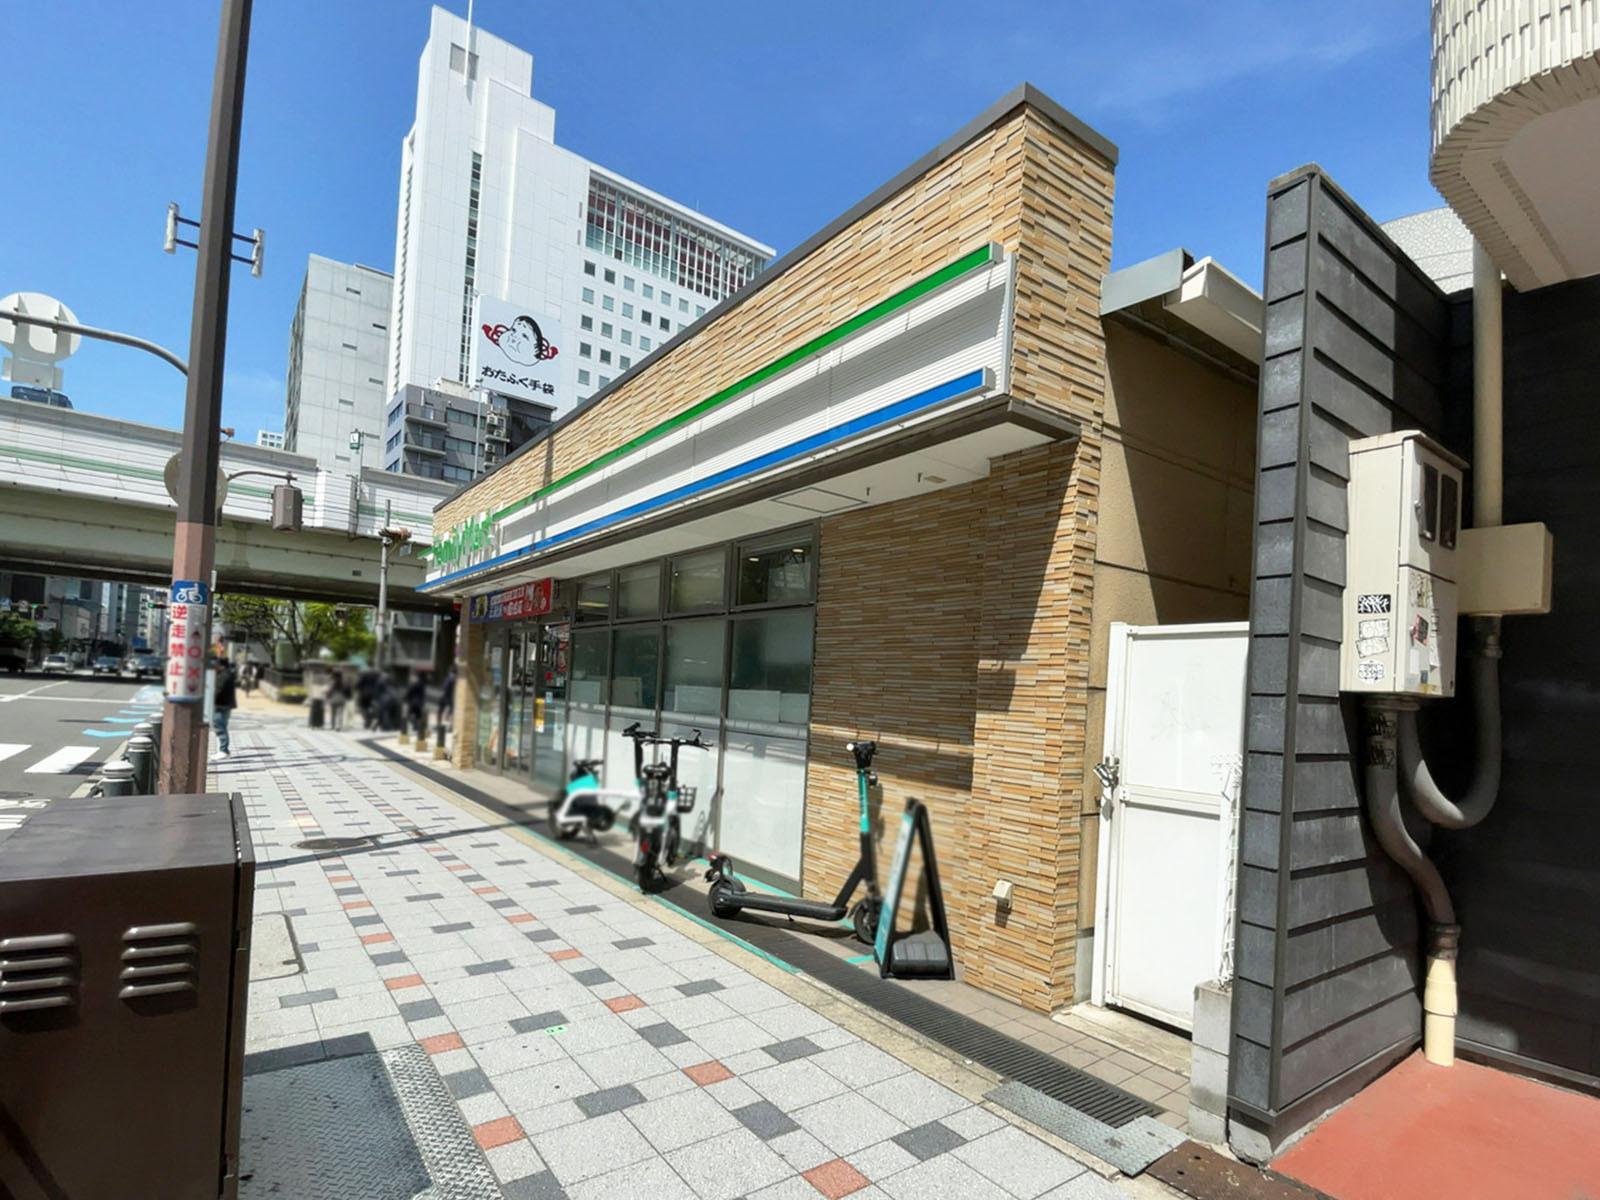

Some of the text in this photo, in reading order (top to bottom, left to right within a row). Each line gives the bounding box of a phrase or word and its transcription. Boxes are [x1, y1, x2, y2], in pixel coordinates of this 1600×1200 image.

[481, 366, 555, 396] おたふく手袋
